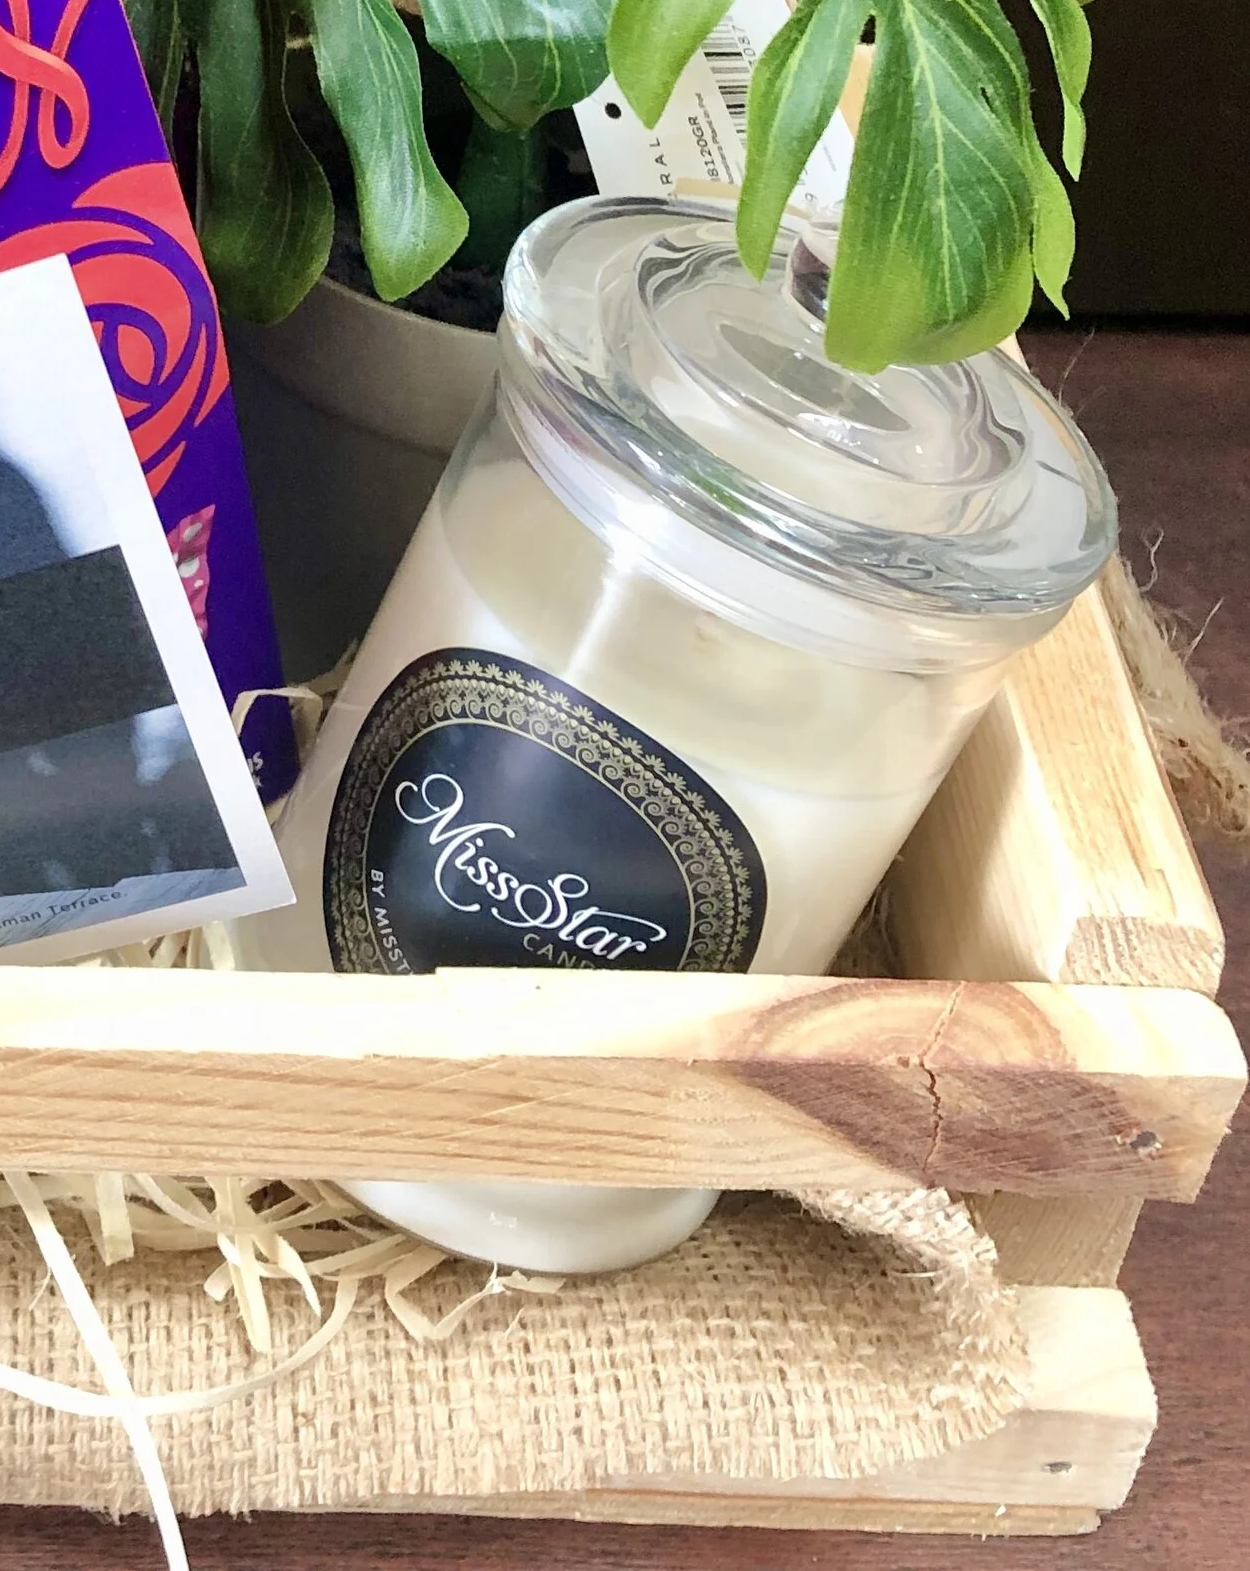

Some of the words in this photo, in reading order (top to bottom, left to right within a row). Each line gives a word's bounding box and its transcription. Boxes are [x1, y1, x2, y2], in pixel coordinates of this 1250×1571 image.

[370, 868, 386, 898] BY
[395, 772, 517, 913] Miss
[491, 873, 668, 961] Star
